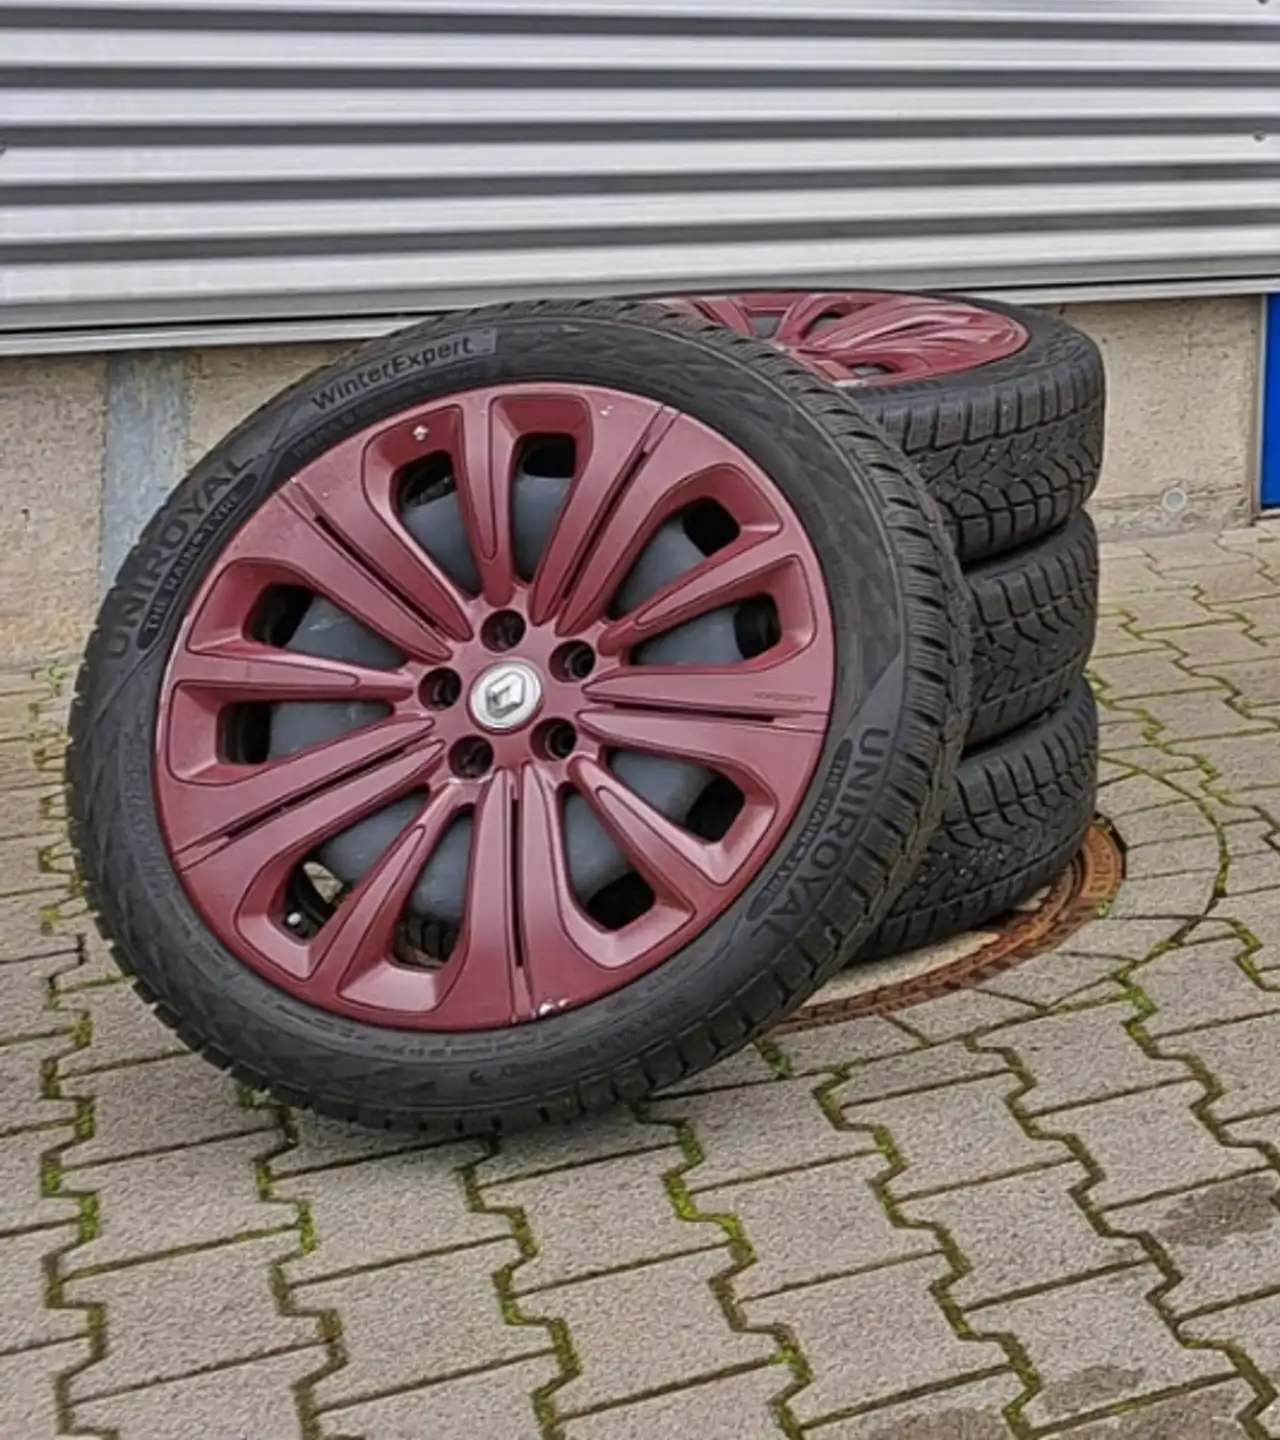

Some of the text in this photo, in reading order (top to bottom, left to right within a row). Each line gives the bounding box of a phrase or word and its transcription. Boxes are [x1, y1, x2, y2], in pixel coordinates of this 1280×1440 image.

[311, 336, 473, 410] WinterExpert
[102, 457, 257, 658] UNIROYAL
[750, 726, 891, 941] UNIROYAL
